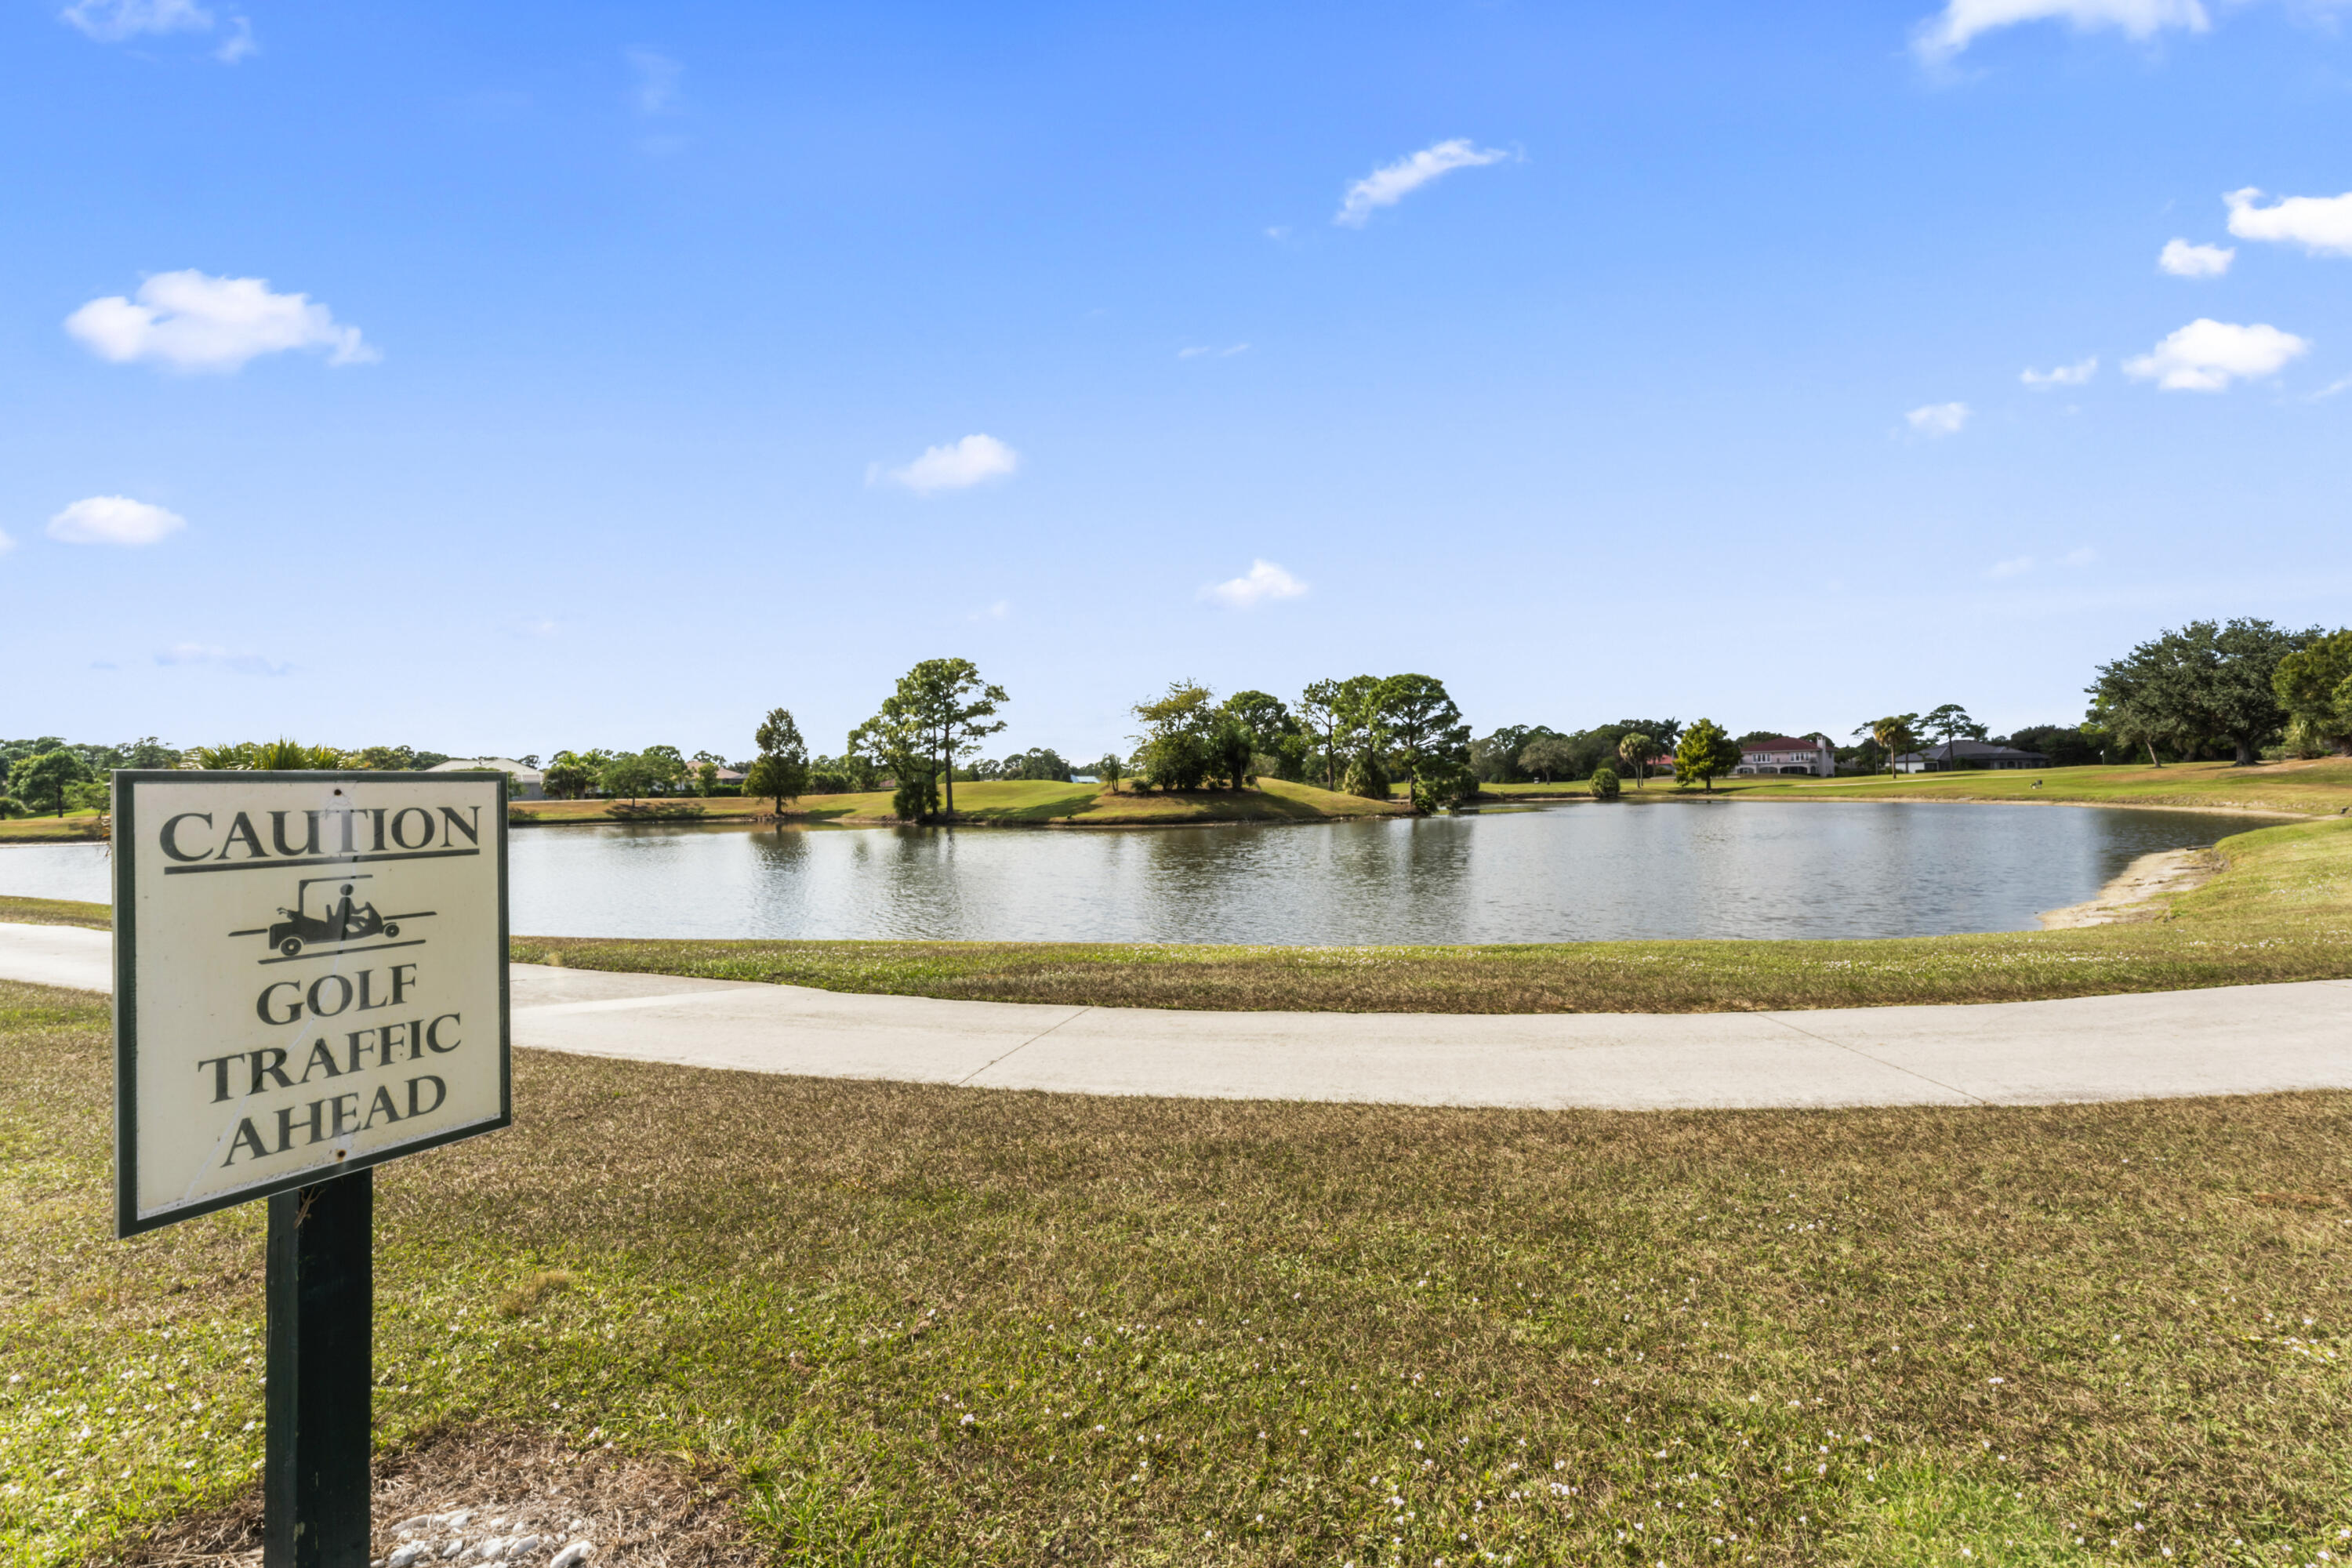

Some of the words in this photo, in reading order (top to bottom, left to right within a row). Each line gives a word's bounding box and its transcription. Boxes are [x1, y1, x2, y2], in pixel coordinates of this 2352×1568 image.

[159, 806, 482, 862] CAUTION
[256, 963, 417, 1025] GOLF
[198, 1012, 462, 1104] TRAFFIC
[220, 1075, 447, 1167] AHEAD
